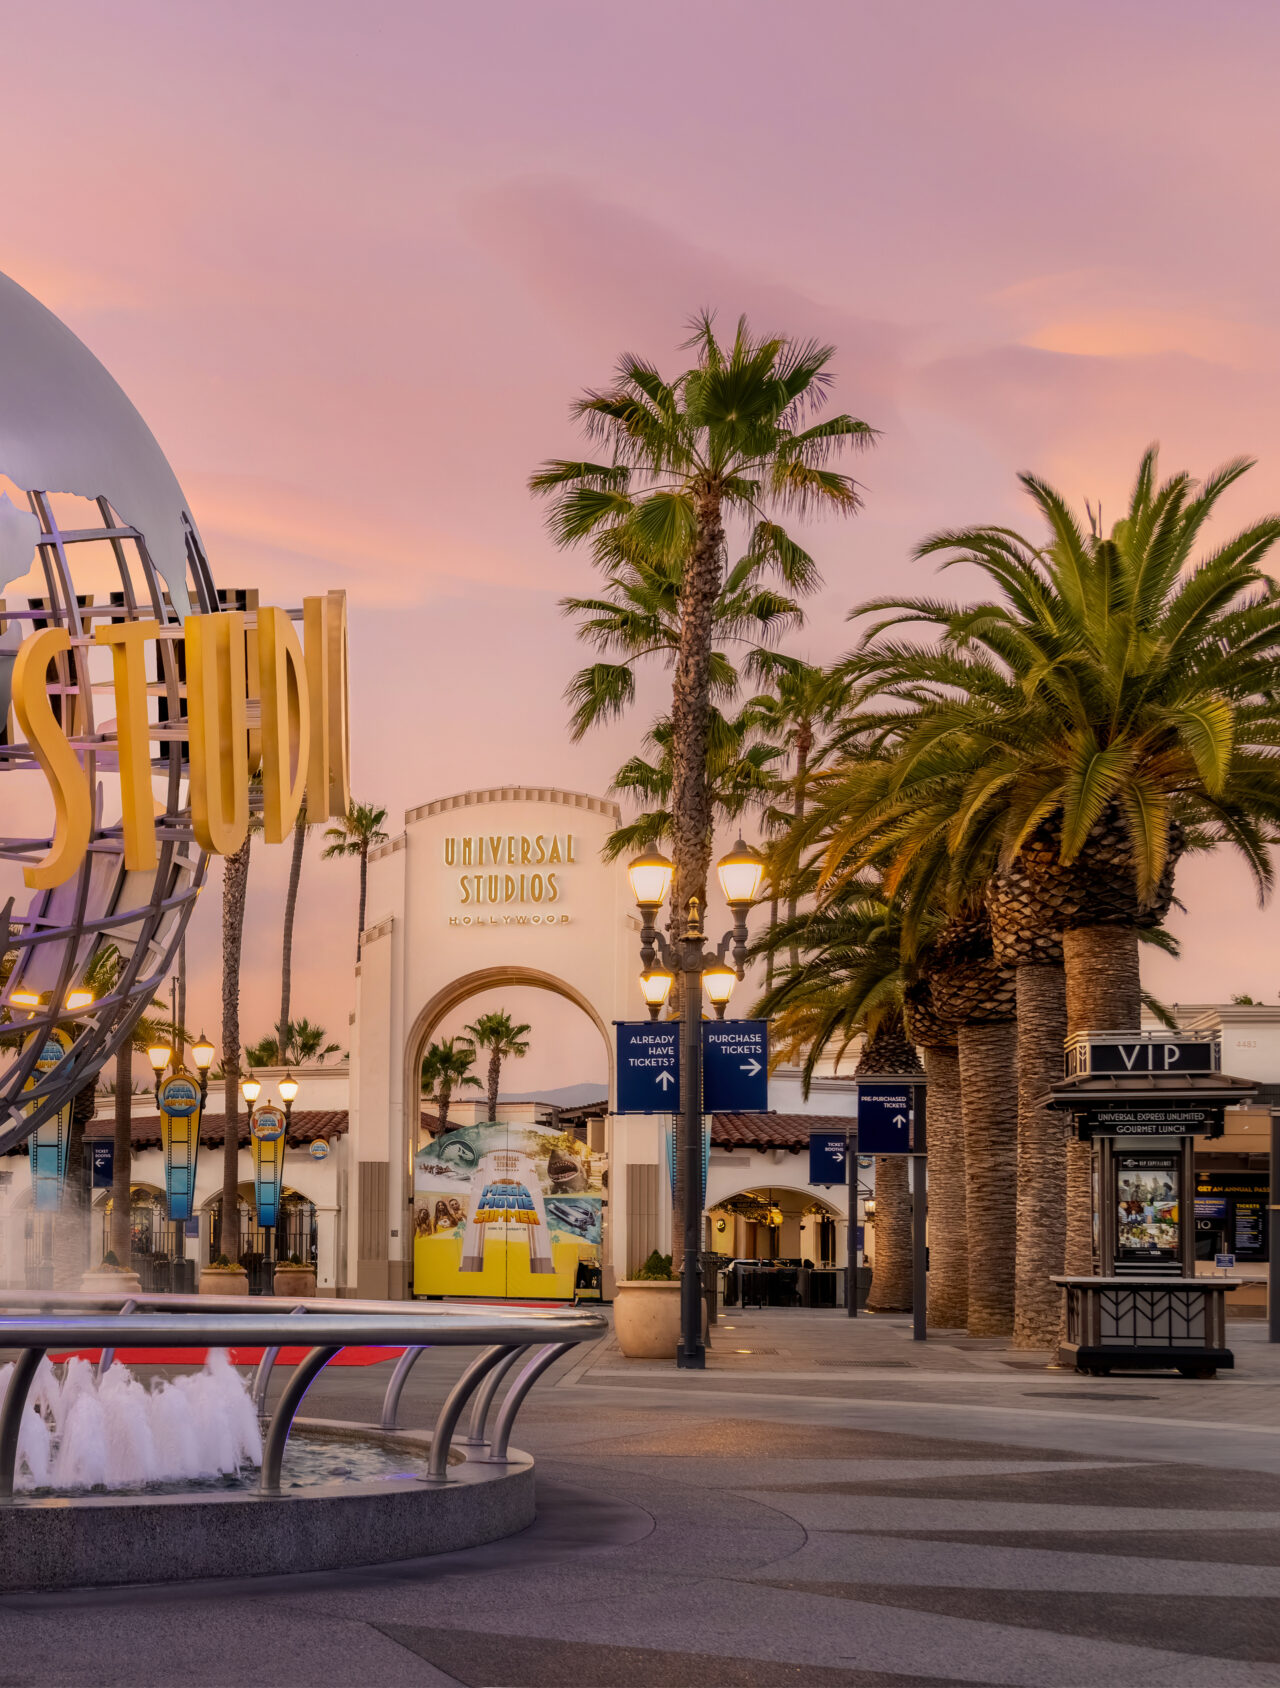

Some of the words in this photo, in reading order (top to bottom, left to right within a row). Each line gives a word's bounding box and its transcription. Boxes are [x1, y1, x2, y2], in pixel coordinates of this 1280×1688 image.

[444, 834, 575, 866] UNIVERSAL
[460, 872, 558, 904] STUDIOS
[449, 915, 569, 925] HOLLYWOOD
[629, 1035, 675, 1044] ALREADY
[708, 1033, 762, 1043] PURCHASE
[648, 1046, 675, 1055] HAVE
[720, 1045, 762, 1054] TICKETS
[628, 1058, 675, 1067] TICKETS?
[1118, 1045, 1180, 1071] VIP
[1097, 1113, 1135, 1121] UNIVERSAL
[1136, 1112, 1165, 1120] EXPRESS
[1166, 1112, 1205, 1120] UNLIMITED
[1116, 1125, 1157, 1133] GOURMET
[1158, 1125, 1186, 1133] LUNCH
[482, 1184, 531, 1197] MEGA
[478, 1197, 535, 1210] MOVIE
[473, 1210, 541, 1225] SUMMER
[1196, 1220, 1211, 1230] 10
